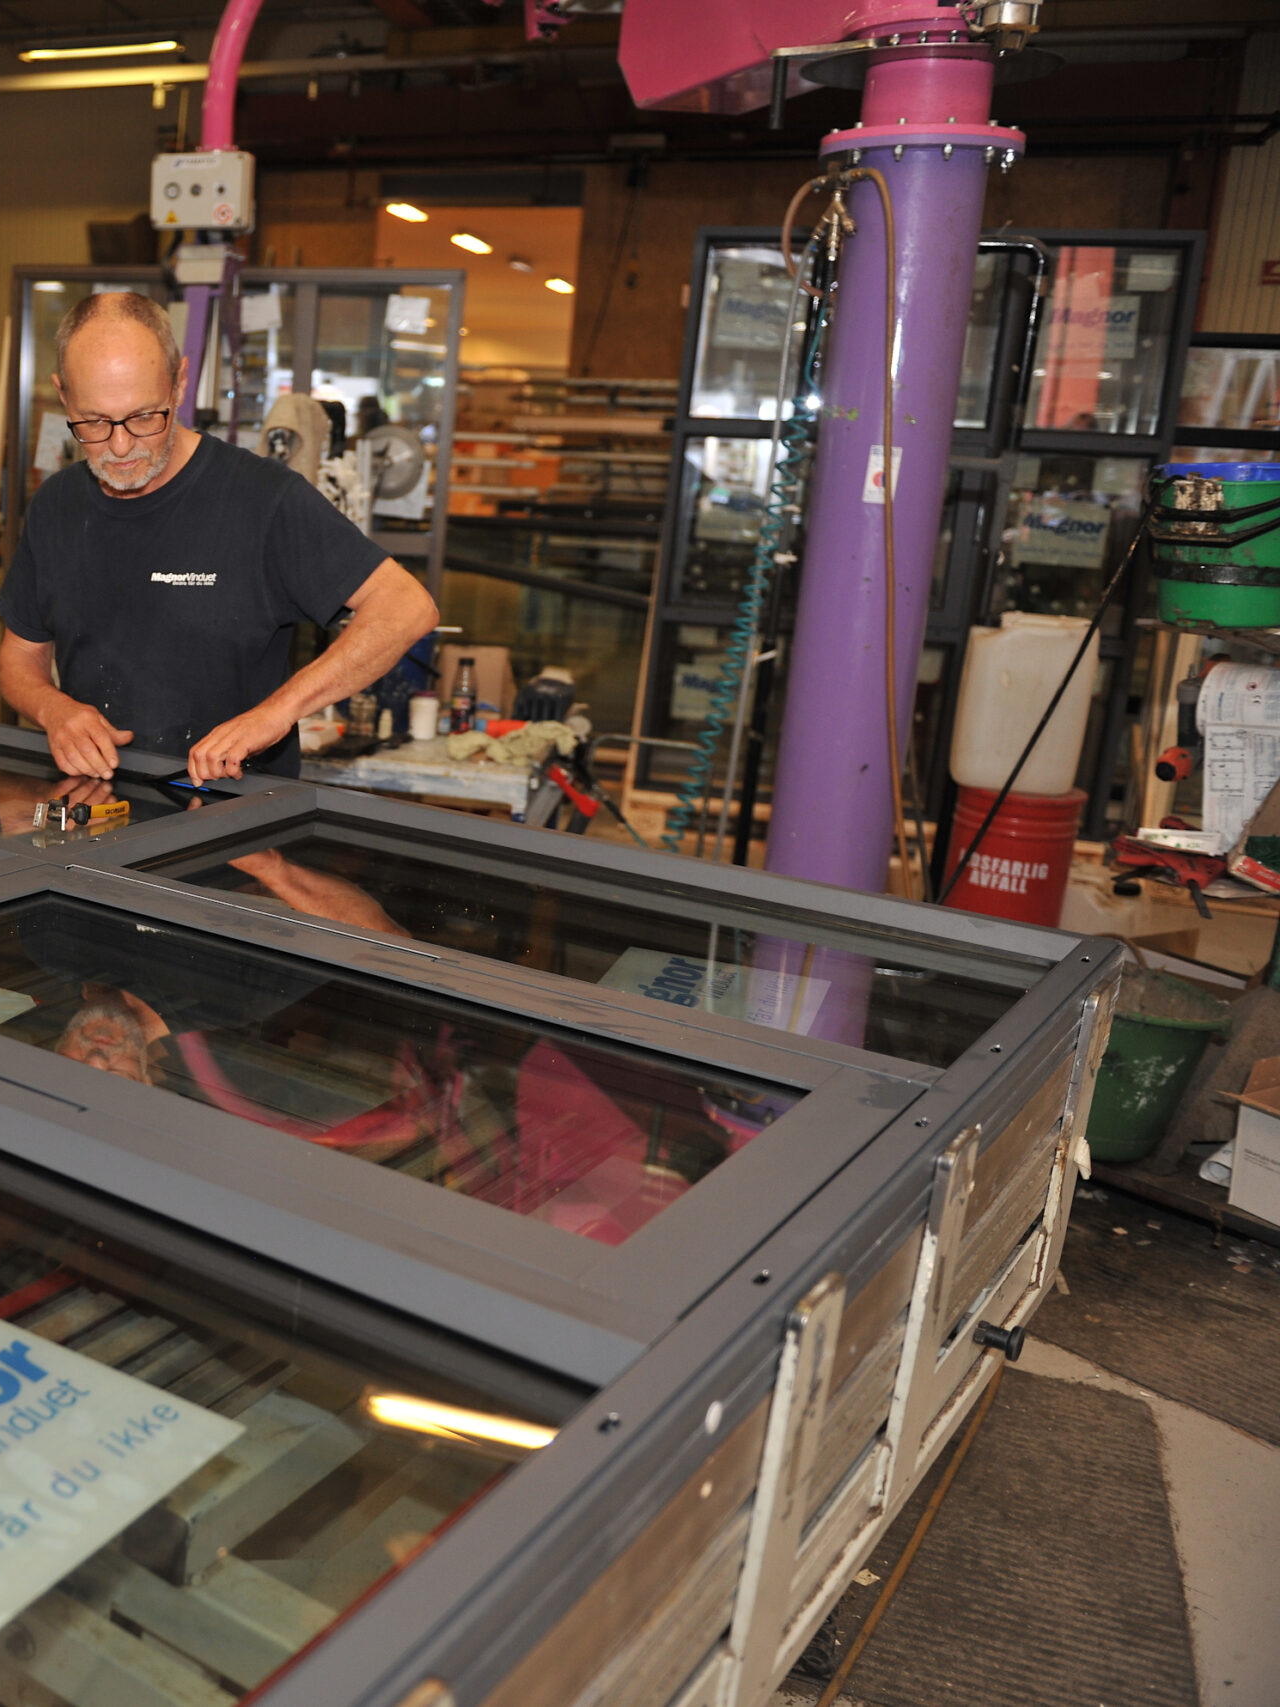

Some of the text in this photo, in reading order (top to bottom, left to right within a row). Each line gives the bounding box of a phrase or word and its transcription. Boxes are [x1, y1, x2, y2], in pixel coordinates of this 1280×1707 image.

[969, 868, 1027, 894] AVFALL
[637, 956, 708, 1009] gnor
[50, 1457, 102, 1500] du
[96, 1400, 182, 1462] ikke
